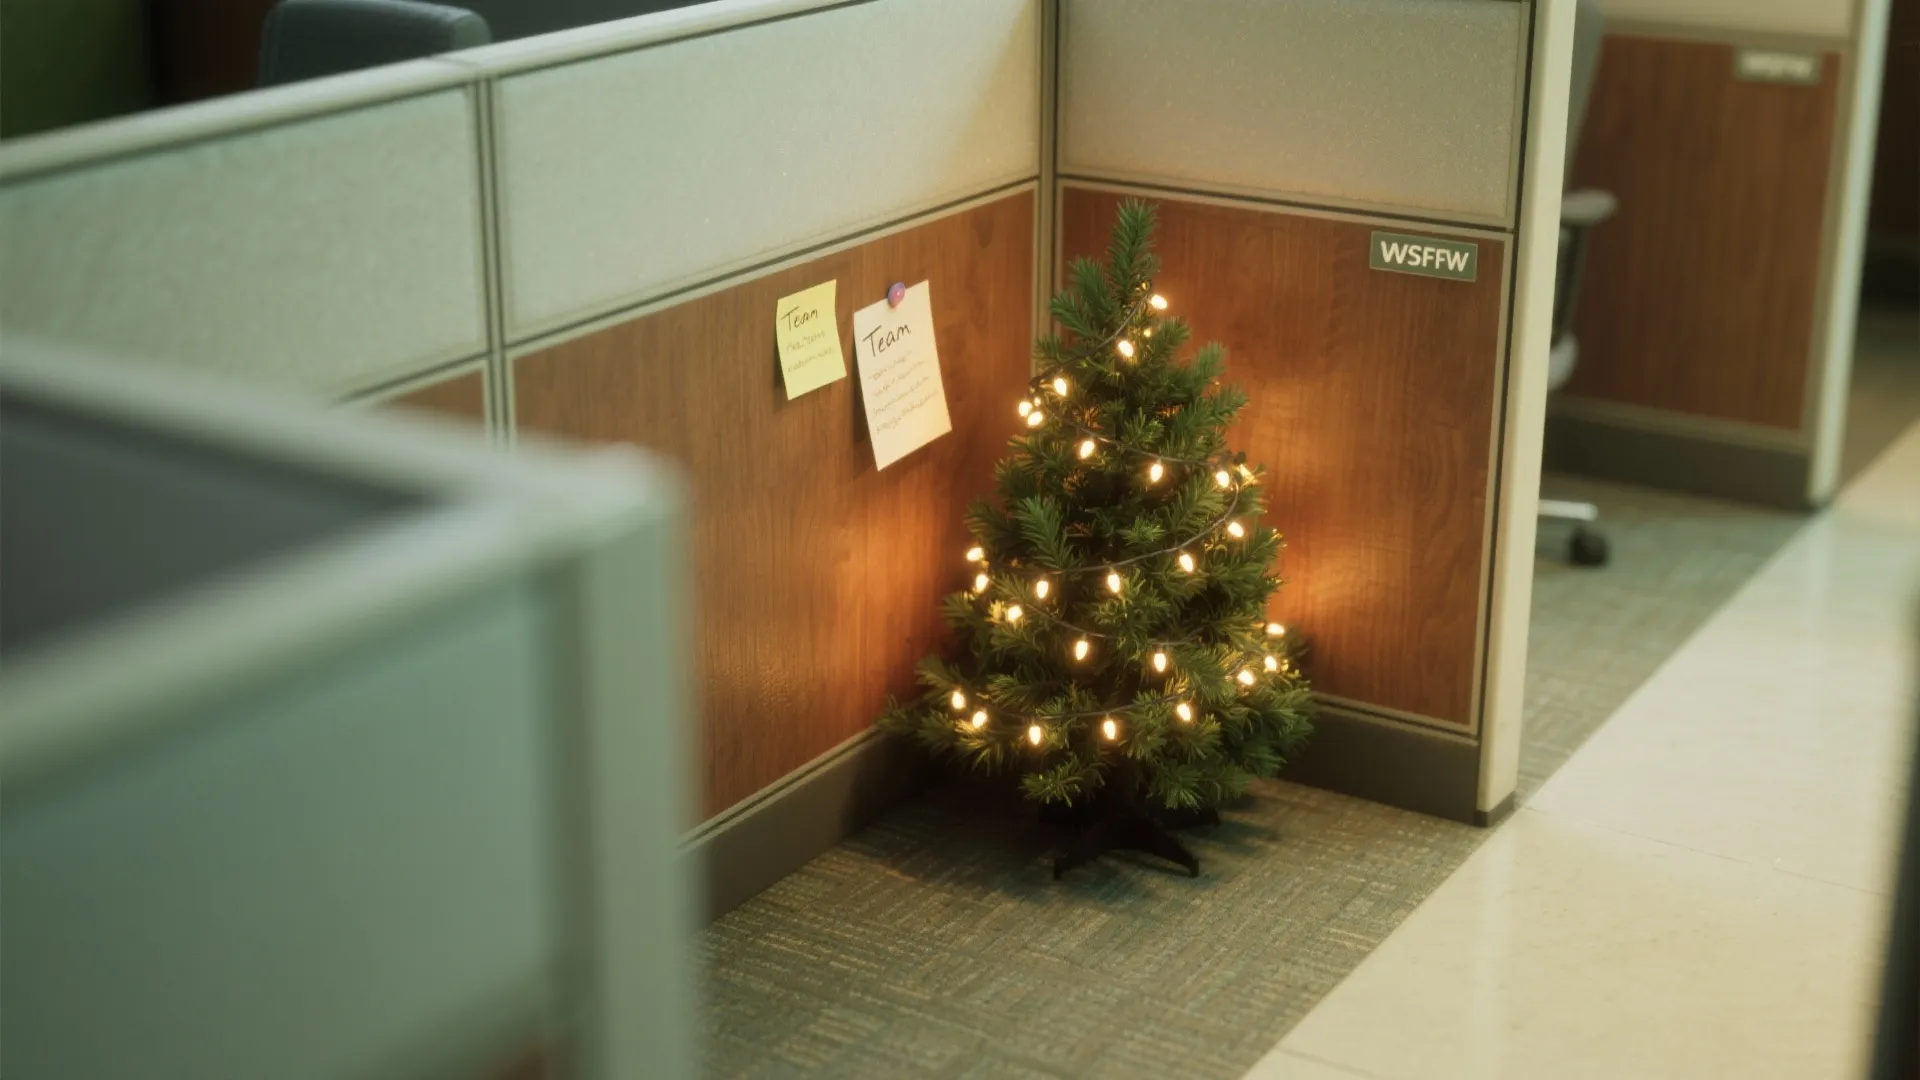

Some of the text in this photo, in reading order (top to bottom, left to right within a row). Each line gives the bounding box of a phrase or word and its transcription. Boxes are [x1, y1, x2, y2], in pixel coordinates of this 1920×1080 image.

[1380, 240, 1470, 272] WSFFW
[780, 306, 819, 332] Team
[862, 324, 912, 357] Team
